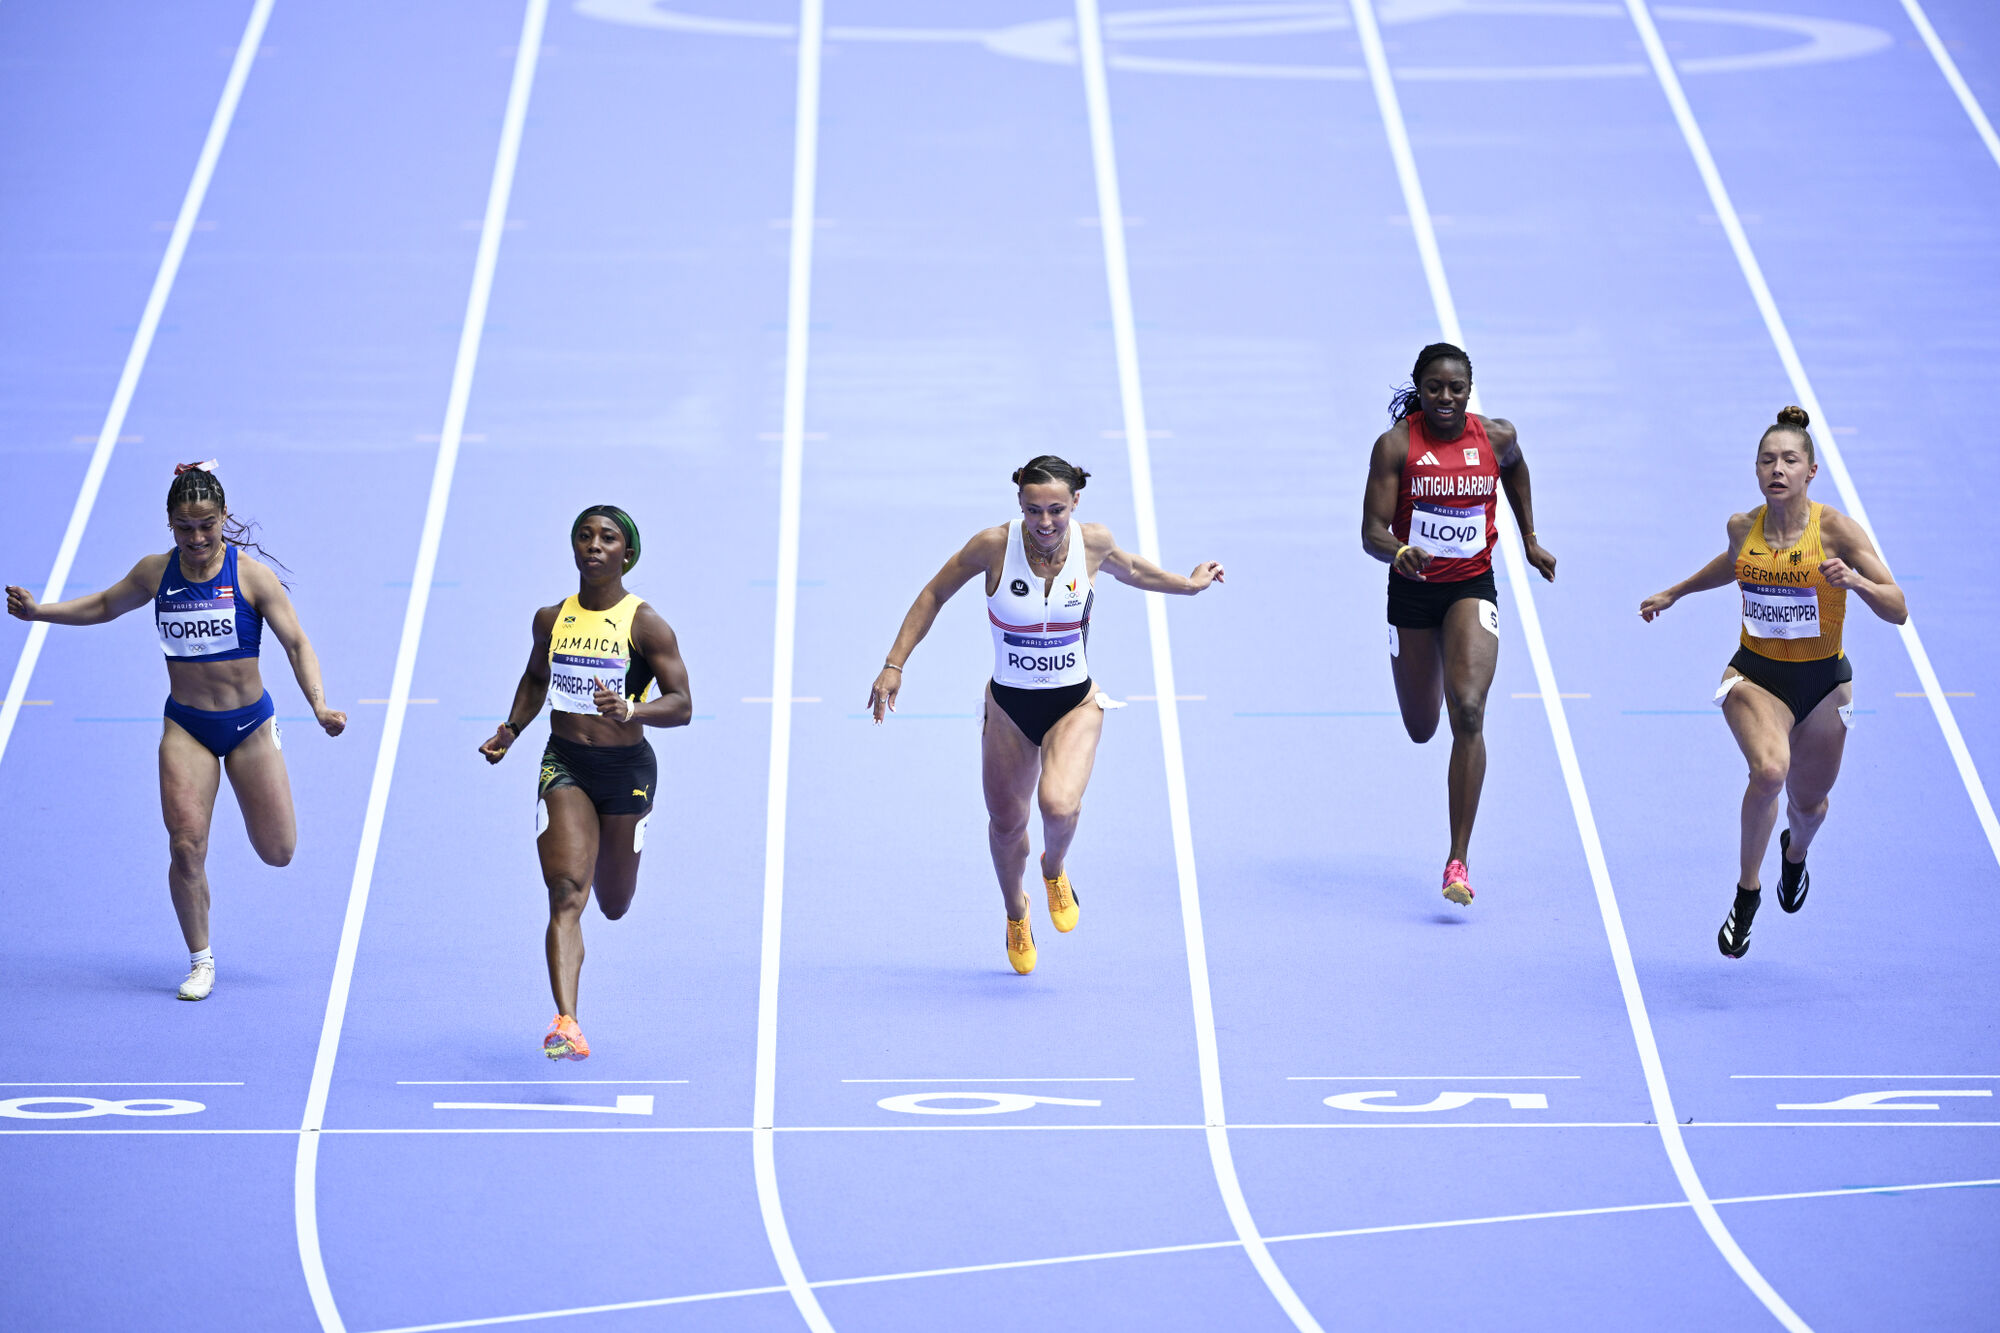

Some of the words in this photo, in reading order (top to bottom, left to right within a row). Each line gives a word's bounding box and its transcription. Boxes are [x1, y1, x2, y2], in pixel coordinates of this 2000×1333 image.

[1411, 476, 1455, 496] ANTIGUA
[1434, 507, 1453, 515] PARIS
[1420, 521, 1477, 542] LLOYD
[1742, 564, 1810, 583] GERMANY
[1757, 586, 1776, 594] PARIS
[1745, 600, 1817, 622] LUECKENKEMPER
[161, 619, 233, 638] TORRES
[553, 638, 620, 656] JAMAICA
[566, 656, 585, 664] PARIS
[1008, 652, 1076, 671] ROSIUS
[0, 1096, 207, 1119] 8
[433, 1095, 654, 1115] 7
[1323, 1090, 1549, 1113] 5
